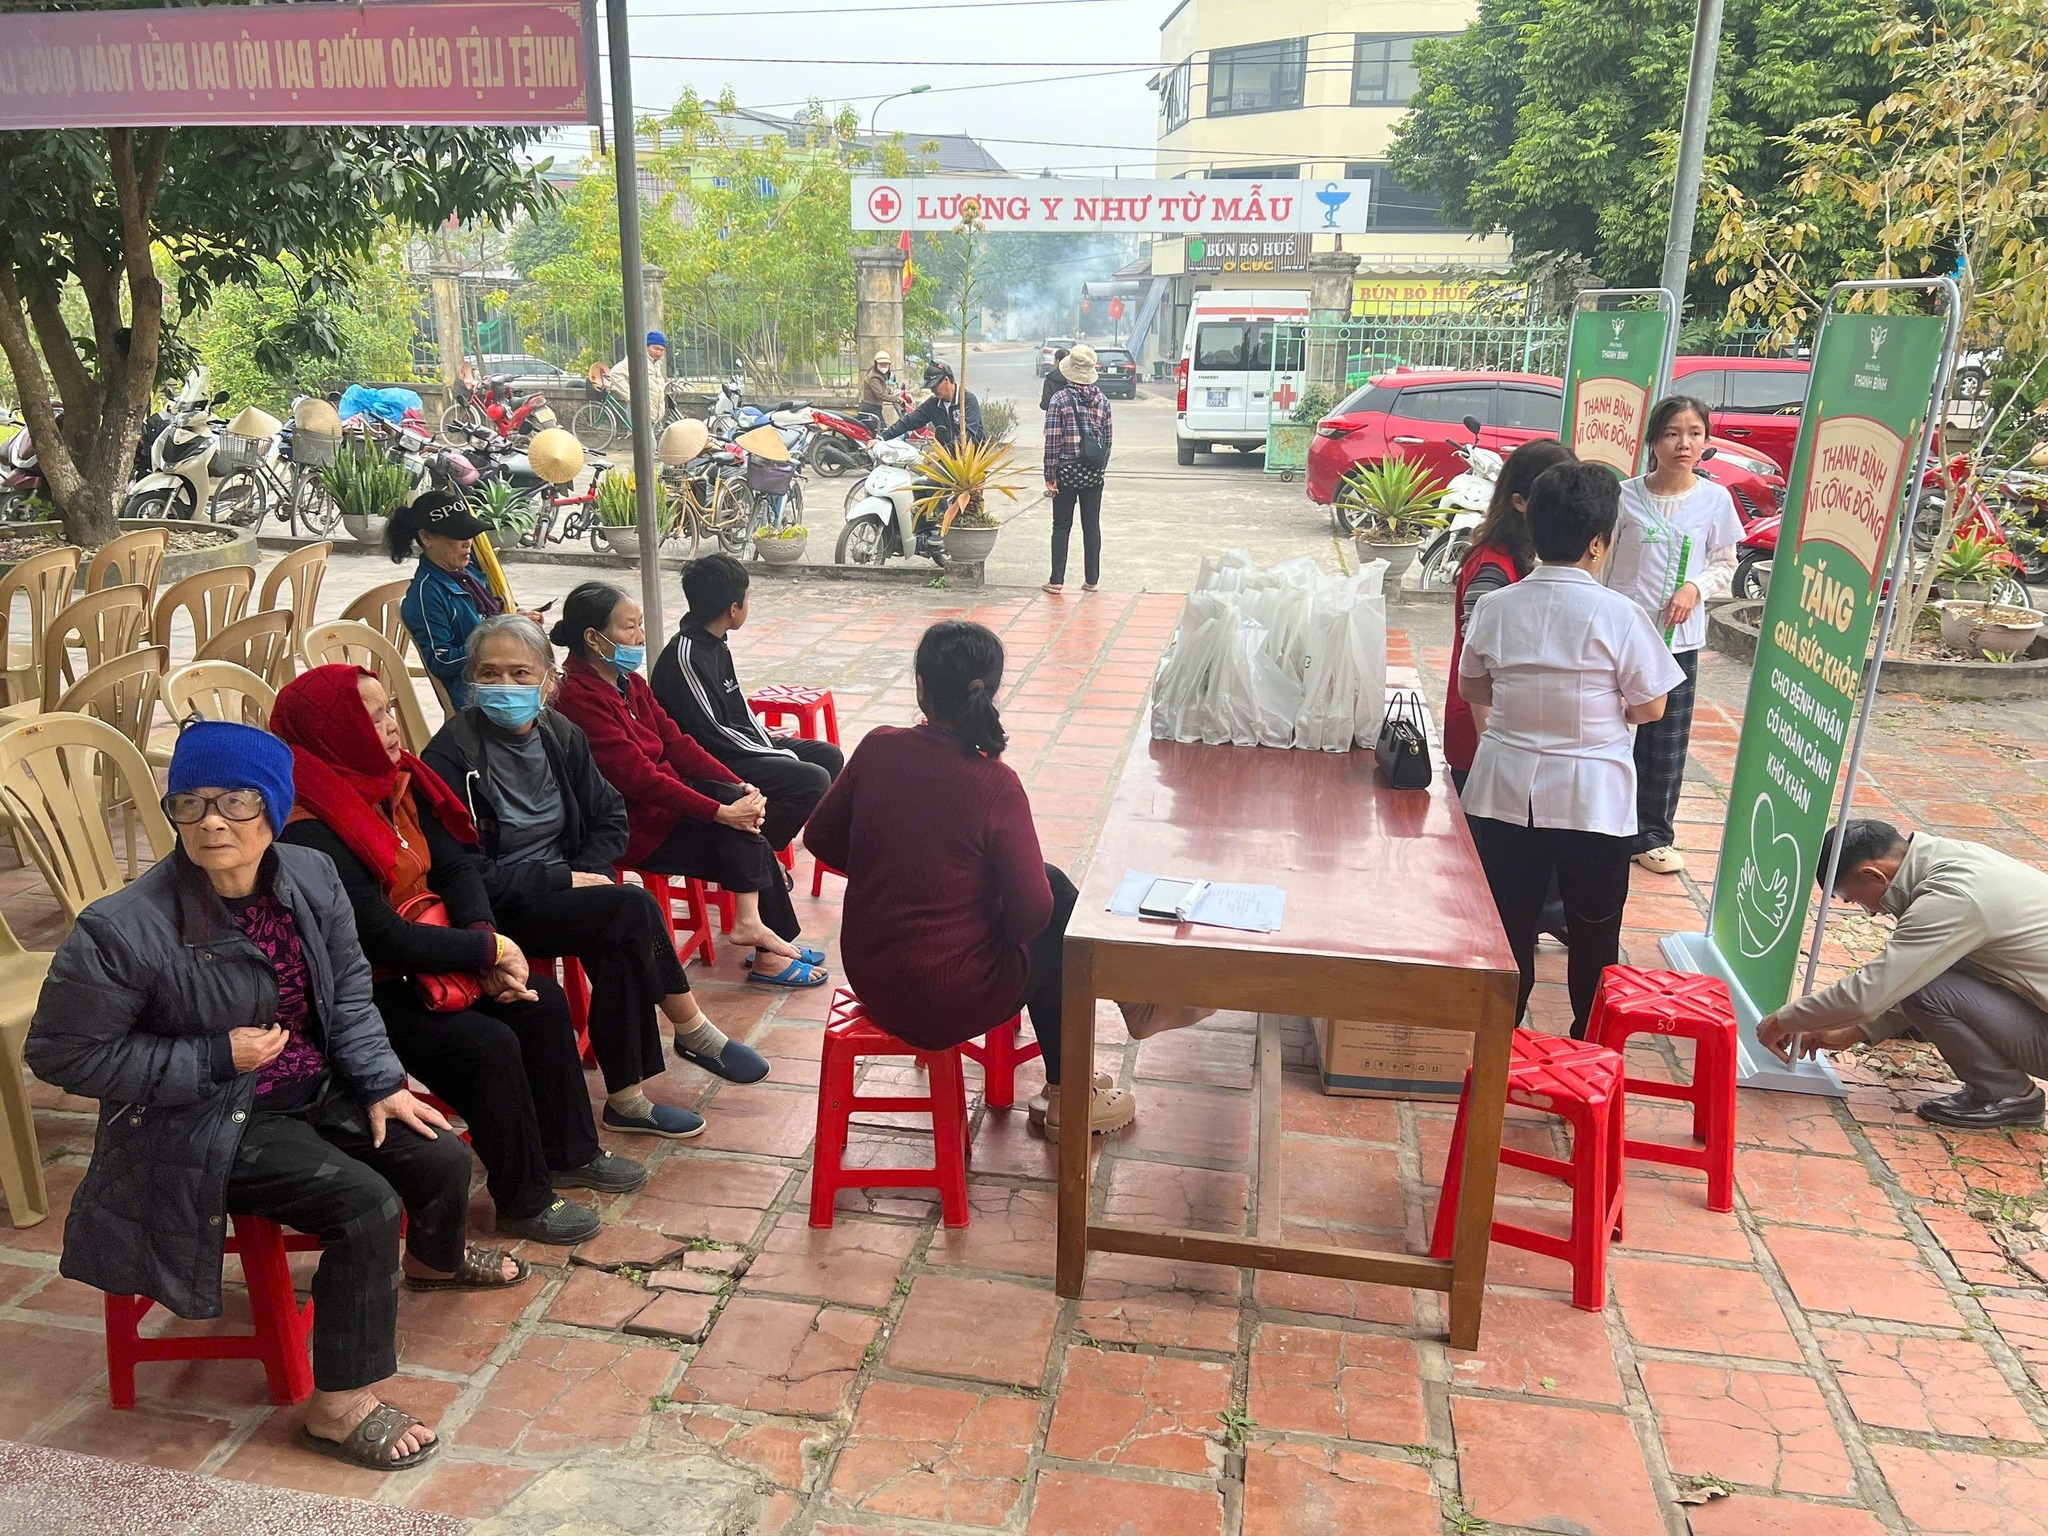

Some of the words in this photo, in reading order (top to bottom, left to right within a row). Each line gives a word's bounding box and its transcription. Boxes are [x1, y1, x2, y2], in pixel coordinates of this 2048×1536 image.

[917, 193, 1030, 220] LƯƠNG
[1040, 197, 1063, 220] Y
[1073, 194, 1152, 222] NHƯ
[1158, 190, 1206, 222] TỪ
[1211, 184, 1293, 222] MẪU
[1207, 239, 1236, 257] BÚN
[1263, 235, 1295, 256] HUẾ
[1360, 283, 1398, 300] BÚN
[1403, 283, 1427, 300] BÒ
[1584, 396, 1612, 418] THANH
[1613, 394, 1635, 425] BÌNH
[1586, 418, 1609, 443] CỘNG
[1610, 420, 1636, 456] ĐỒNG
[1822, 444, 1858, 473] THANH
[1859, 444, 1888, 493] BÌNH
[1821, 477, 1851, 514] CỘNG
[1852, 483, 1885, 541] ĐỒNG
[1800, 558, 1854, 634] TẶNG
[1774, 620, 1799, 657] QUÀ
[1798, 633, 1823, 675] SỨC
[1822, 655, 1859, 701] KHỎE
[1771, 668, 1789, 699] CHO
[1788, 681, 1815, 721] BỆNH
[1813, 702, 1844, 745] NHÂN
[1766, 706, 1780, 734] CÓ
[1778, 724, 1804, 759] HOÀN
[1803, 743, 1832, 785] CẢNH
[1766, 752, 1786, 786] KHÓ
[1784, 779, 1811, 814] KHĂN
[1656, 1019, 1676, 1032] 50
